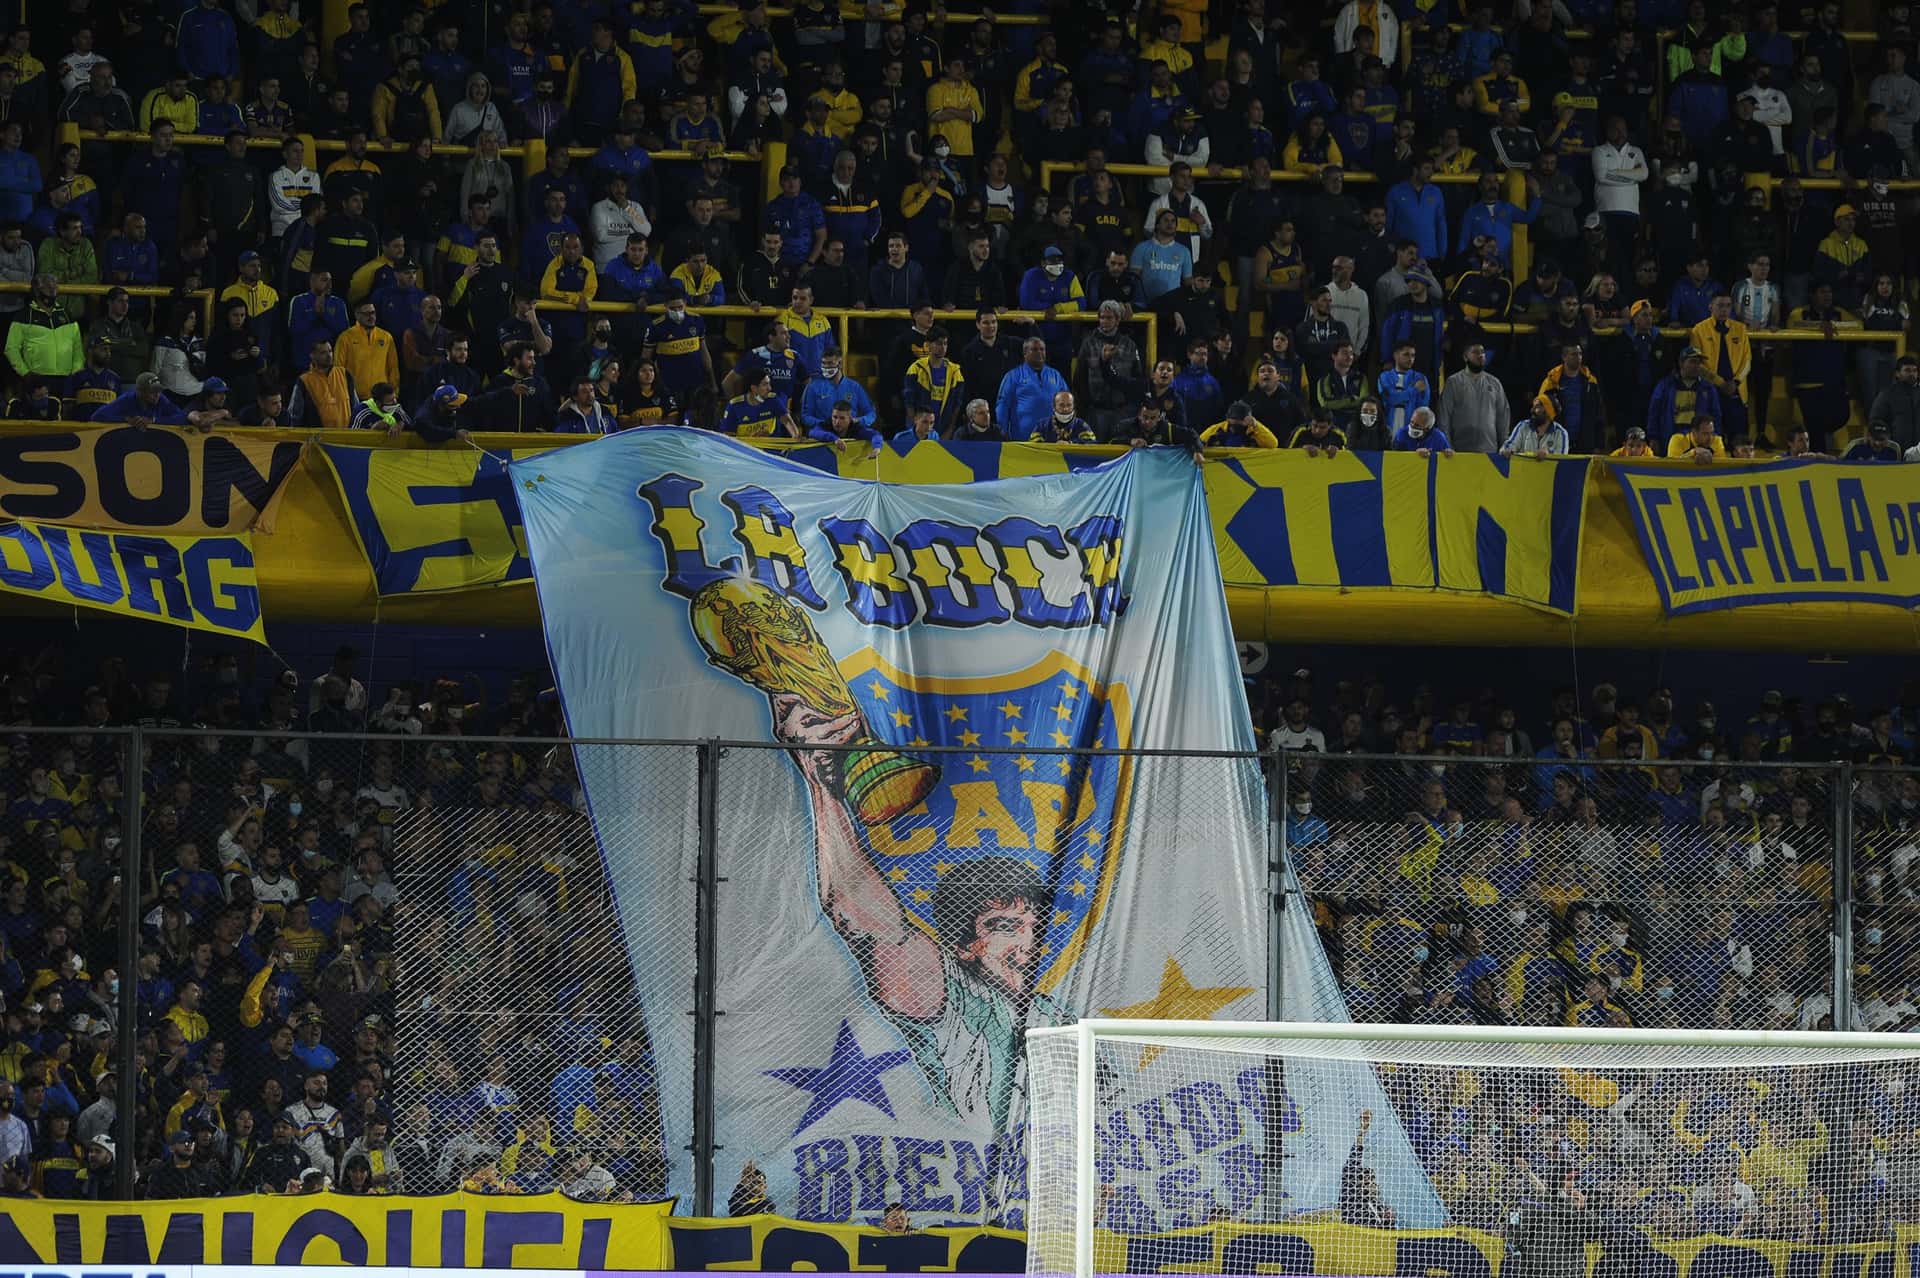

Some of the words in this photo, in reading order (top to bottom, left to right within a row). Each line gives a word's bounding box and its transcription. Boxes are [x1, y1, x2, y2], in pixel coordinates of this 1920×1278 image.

[637, 472, 827, 612] LA
[818, 513, 1130, 630] BOCA
[1639, 478, 1889, 592] CAPILLA
